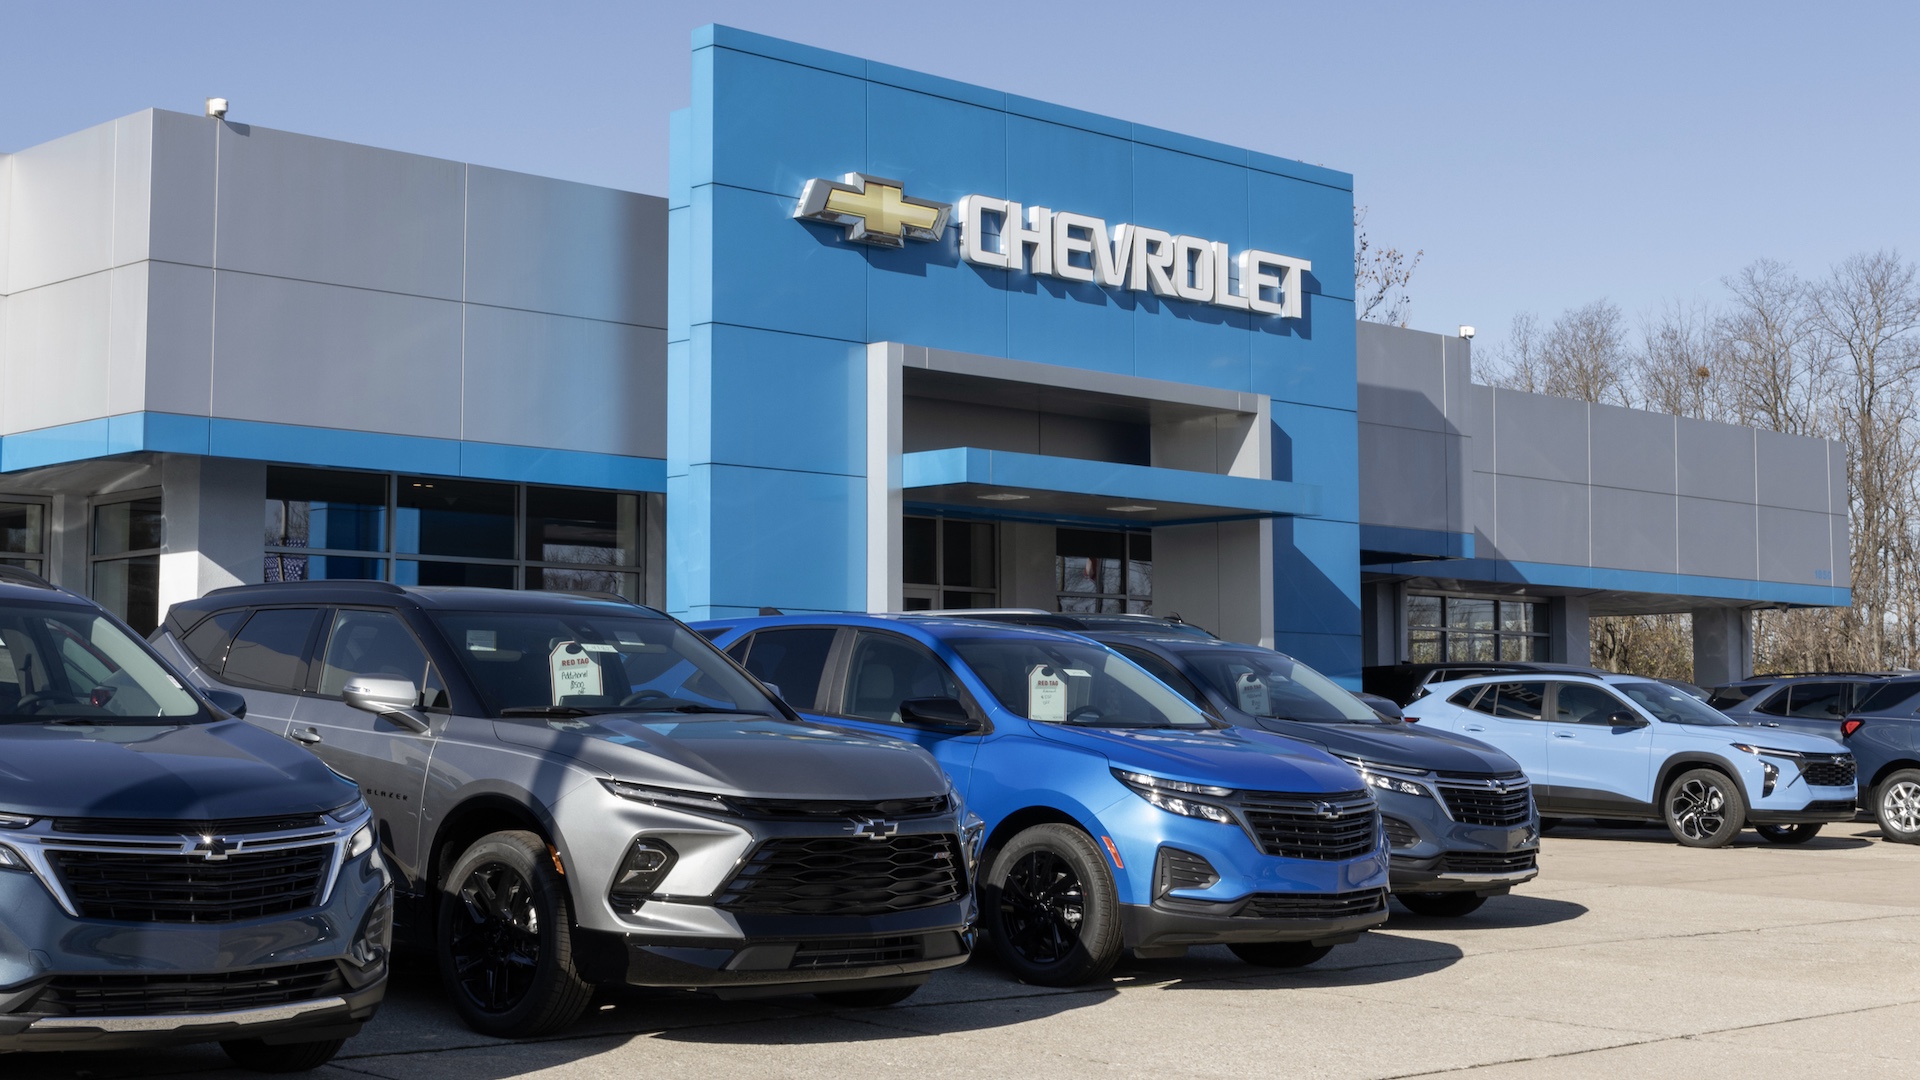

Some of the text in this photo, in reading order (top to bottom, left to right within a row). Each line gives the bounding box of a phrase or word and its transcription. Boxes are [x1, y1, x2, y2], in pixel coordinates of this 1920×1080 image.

[958, 193, 1311, 319] CHEVROLET
[562, 659, 576, 667] RED
[366, 788, 408, 800] BLAZER
